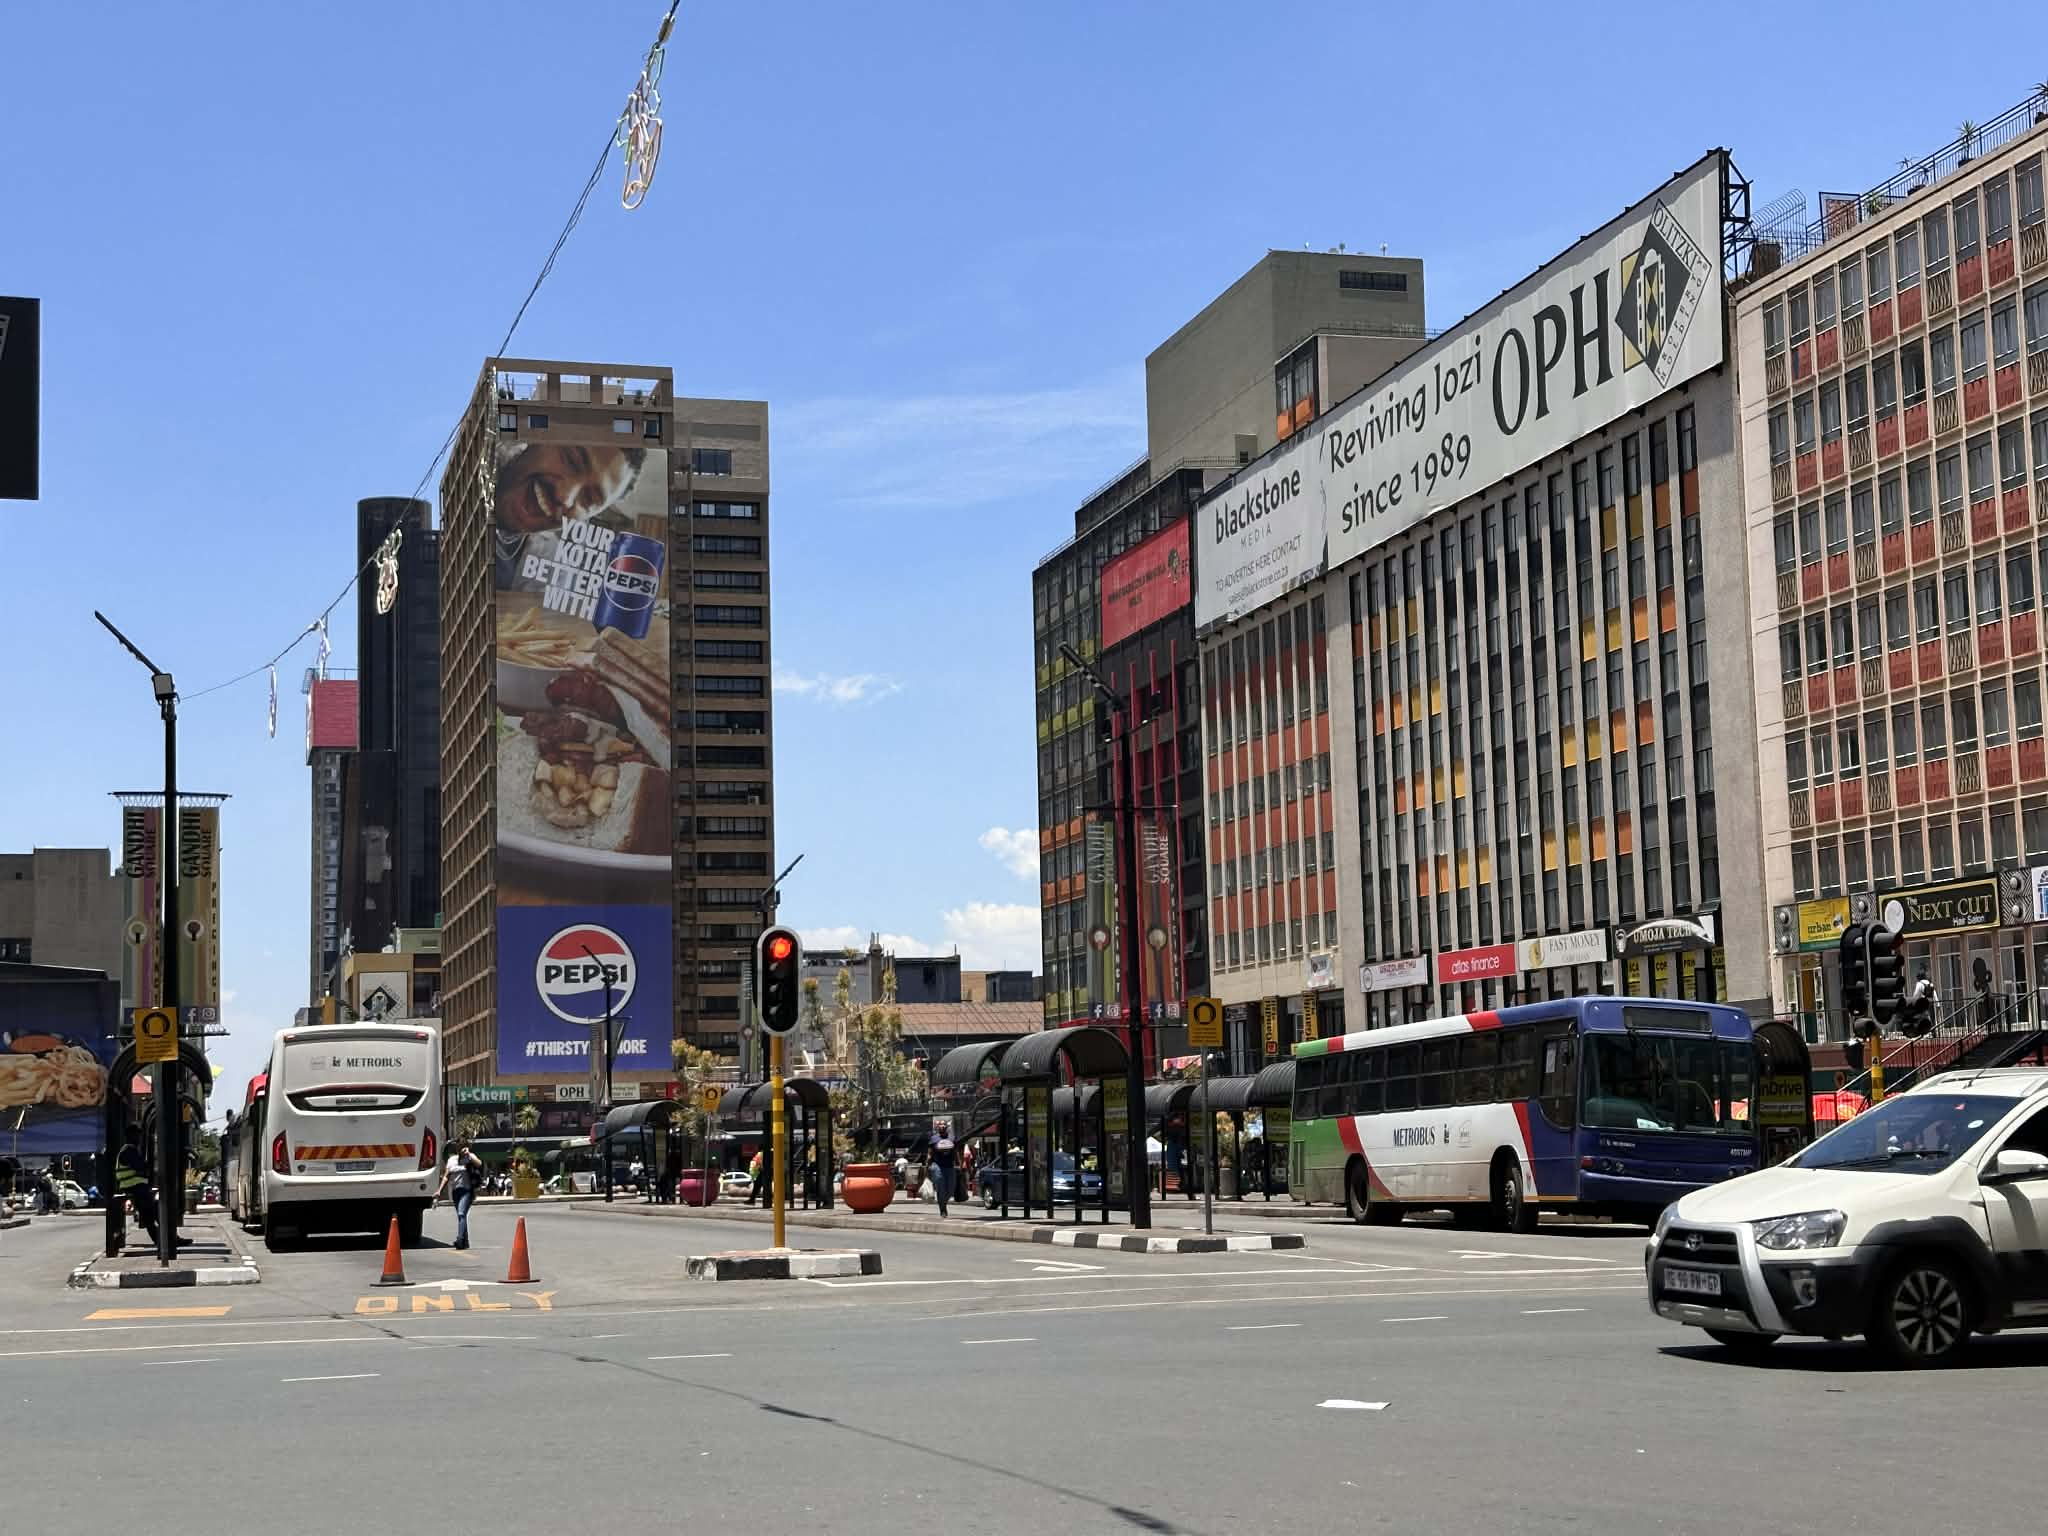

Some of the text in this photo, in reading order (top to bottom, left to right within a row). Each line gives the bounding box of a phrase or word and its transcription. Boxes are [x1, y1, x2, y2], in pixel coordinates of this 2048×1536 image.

[1653, 206, 1699, 275] OLITZKI
[1492, 267, 1615, 436] OPH
[1329, 334, 1481, 473] Reviving Jozi
[1341, 432, 1471, 534] since 1989
[1216, 468, 1301, 545] blackstone
[561, 515, 616, 553] YOUR
[1240, 522, 1272, 549] MEDIA
[1271, 534, 1301, 564] CONTACT
[553, 540, 609, 576] KOTA
[522, 554, 604, 600] BETTER
[606, 570, 657, 595] PEPSI
[543, 585, 599, 622] WITH
[126, 811, 145, 879] GANDHI
[183, 811, 201, 879] GANDHI
[200, 829, 212, 880] SQUARE
[1087, 825, 1105, 884] GANDHI
[1143, 825, 1160, 884] GANDHI
[1160, 834, 1169, 884] SQUARE
[1908, 894, 1992, 923] NEXT CUT
[1953, 914, 1985, 927] Hair Salon
[1549, 932, 1601, 953] FAST MONEY
[1633, 925, 1692, 944] UMOJA TECH
[1807, 922, 1832, 937] urban
[544, 964, 628, 986] PEPSI
[1451, 954, 1500, 975] atlas finance
[346, 1057, 402, 1068] METROBUS
[559, 1087, 584, 1098] OPH
[1393, 1127, 1436, 1147] METROBUS
[354, 1288, 561, 1315] ONLY
